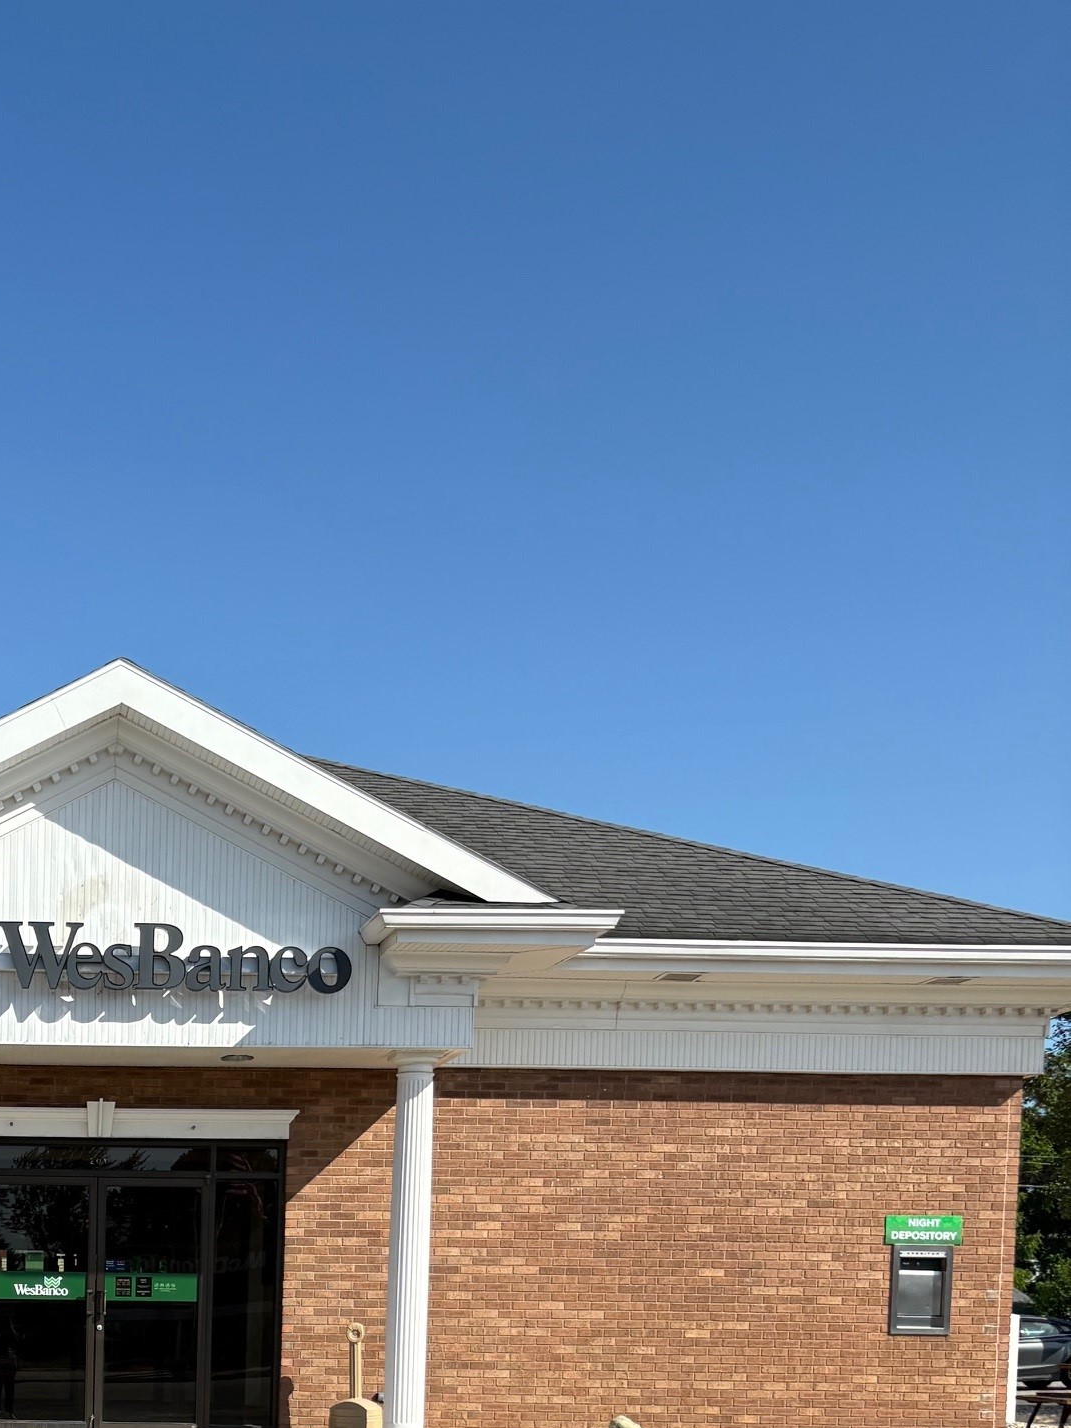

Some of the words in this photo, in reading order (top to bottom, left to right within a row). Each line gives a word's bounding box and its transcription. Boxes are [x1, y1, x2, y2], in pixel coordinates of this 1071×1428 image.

[907, 1218, 941, 1228] NIGHT
[890, 1231, 958, 1241] DEPOSITORY
[13, 1283, 69, 1297] WesBanco
